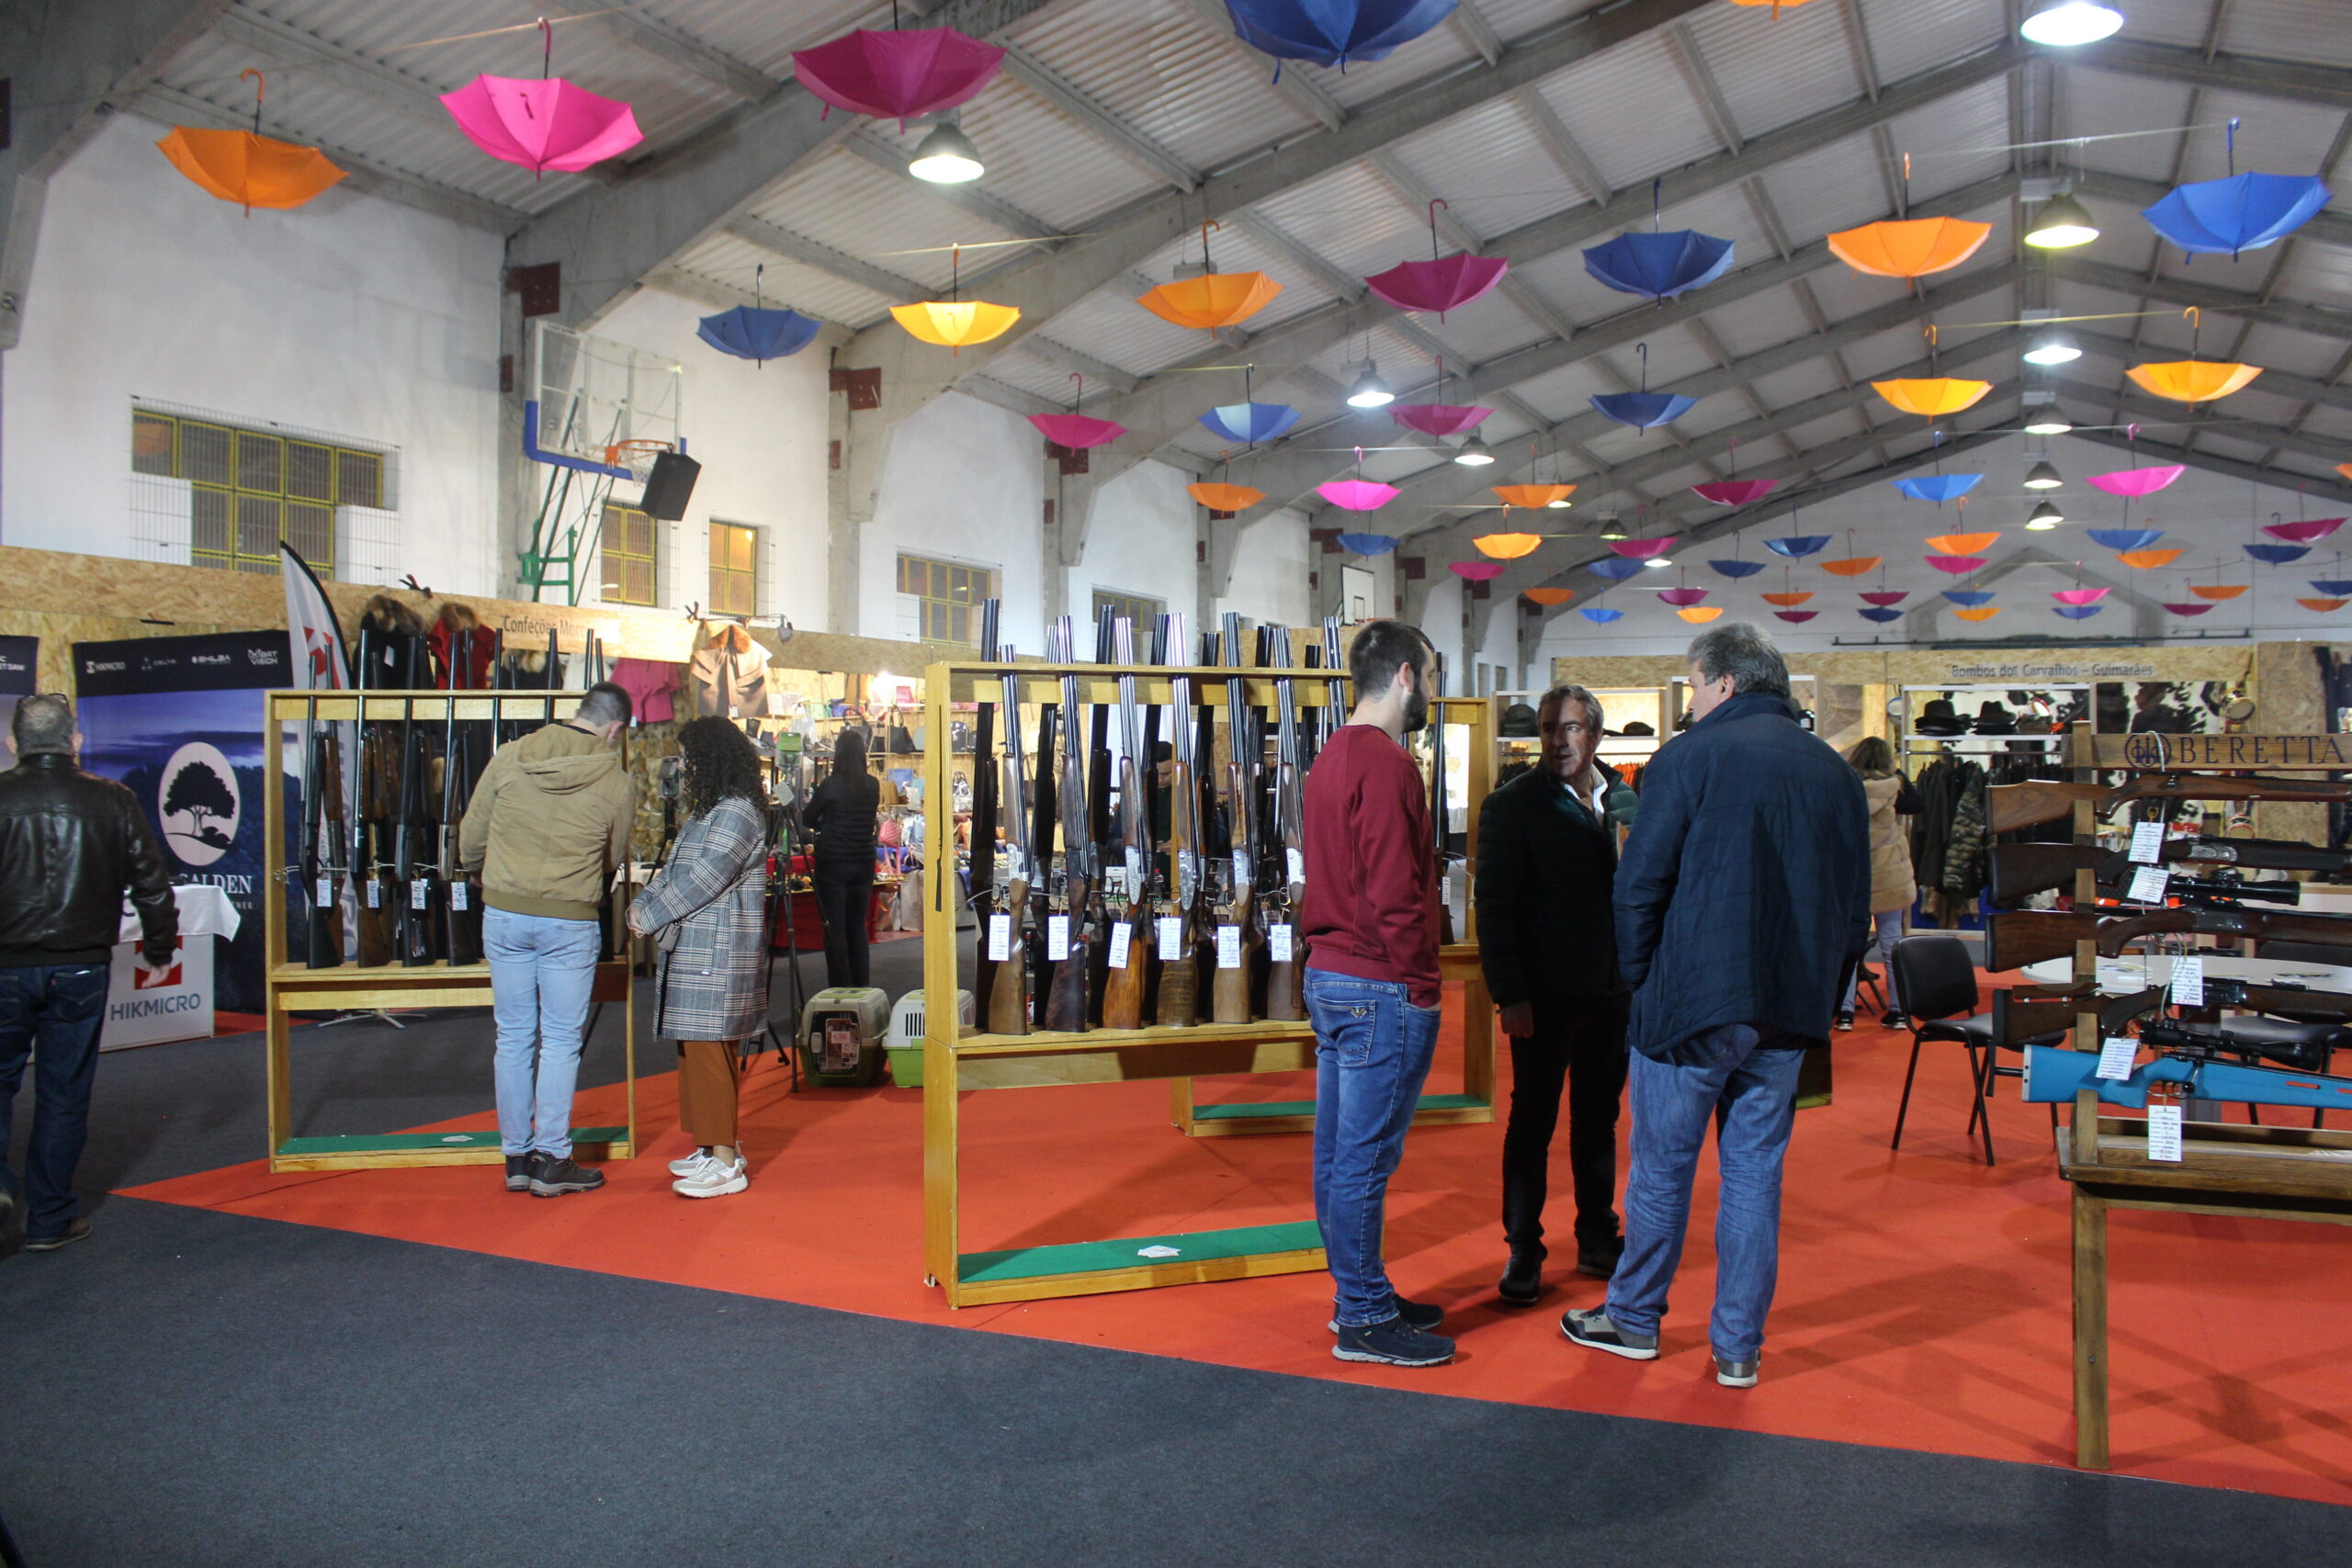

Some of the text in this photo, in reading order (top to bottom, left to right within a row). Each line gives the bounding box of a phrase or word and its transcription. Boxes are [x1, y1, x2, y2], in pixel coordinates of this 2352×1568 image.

[1952, 665, 1996, 677] Bombos
[2022, 663, 2078, 677] Carvalhos
[2092, 663, 2154, 676] Guimarães
[2179, 736, 2346, 764] BERETTA
[110, 993, 201, 1021] HIKMICRO
